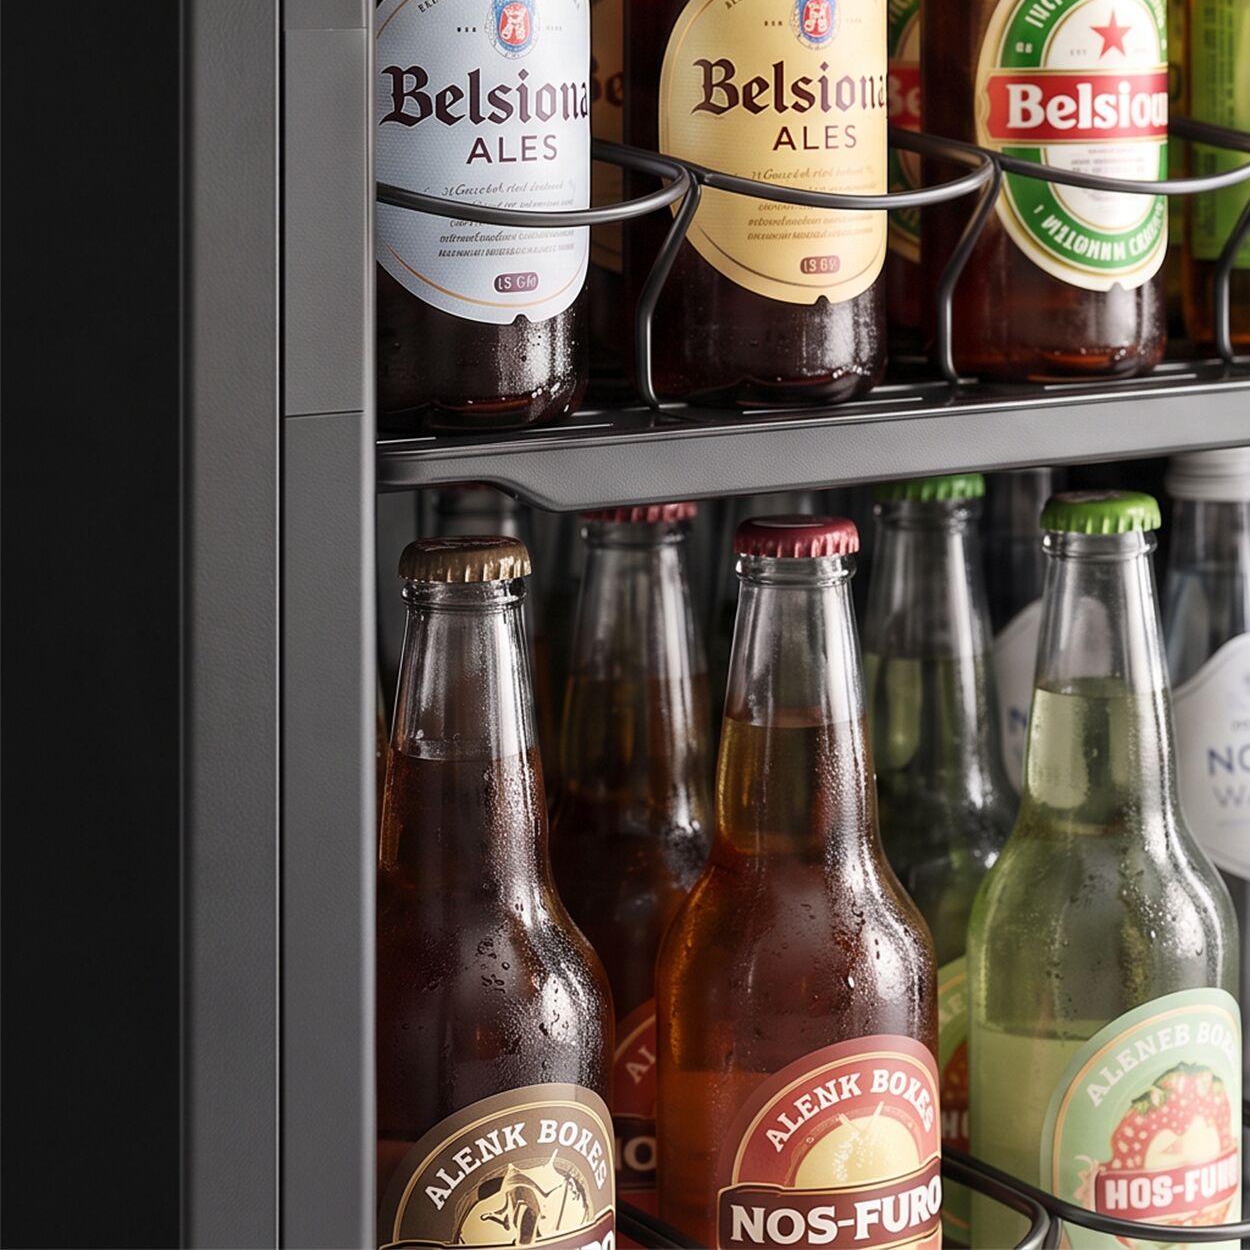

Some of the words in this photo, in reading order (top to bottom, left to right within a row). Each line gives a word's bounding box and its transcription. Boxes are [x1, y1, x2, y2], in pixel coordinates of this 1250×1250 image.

[465, 133, 559, 166] ALES
[773, 124, 858, 151] ALES
[765, 1072, 862, 1152] ALENK
[425, 1122, 528, 1211] ALENK
[730, 1175, 943, 1245] NOS-FURO
